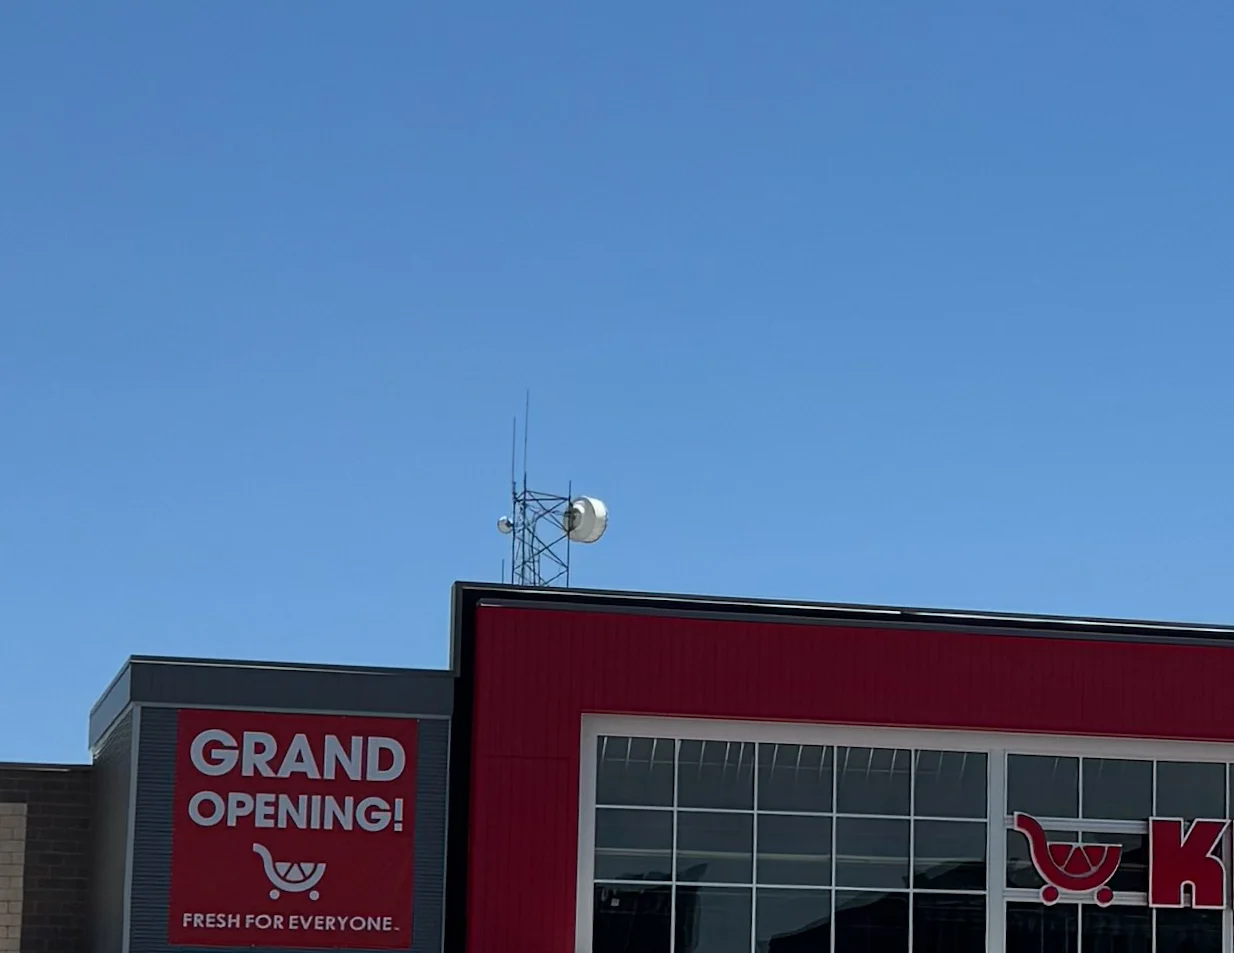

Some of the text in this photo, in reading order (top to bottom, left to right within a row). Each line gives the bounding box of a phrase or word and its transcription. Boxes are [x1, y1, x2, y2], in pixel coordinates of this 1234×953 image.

[190, 728, 406, 782] GRAND
[188, 790, 404, 832] OPENING!
[182, 912, 241, 929] FRESH
[245, 914, 284, 930] FOR
